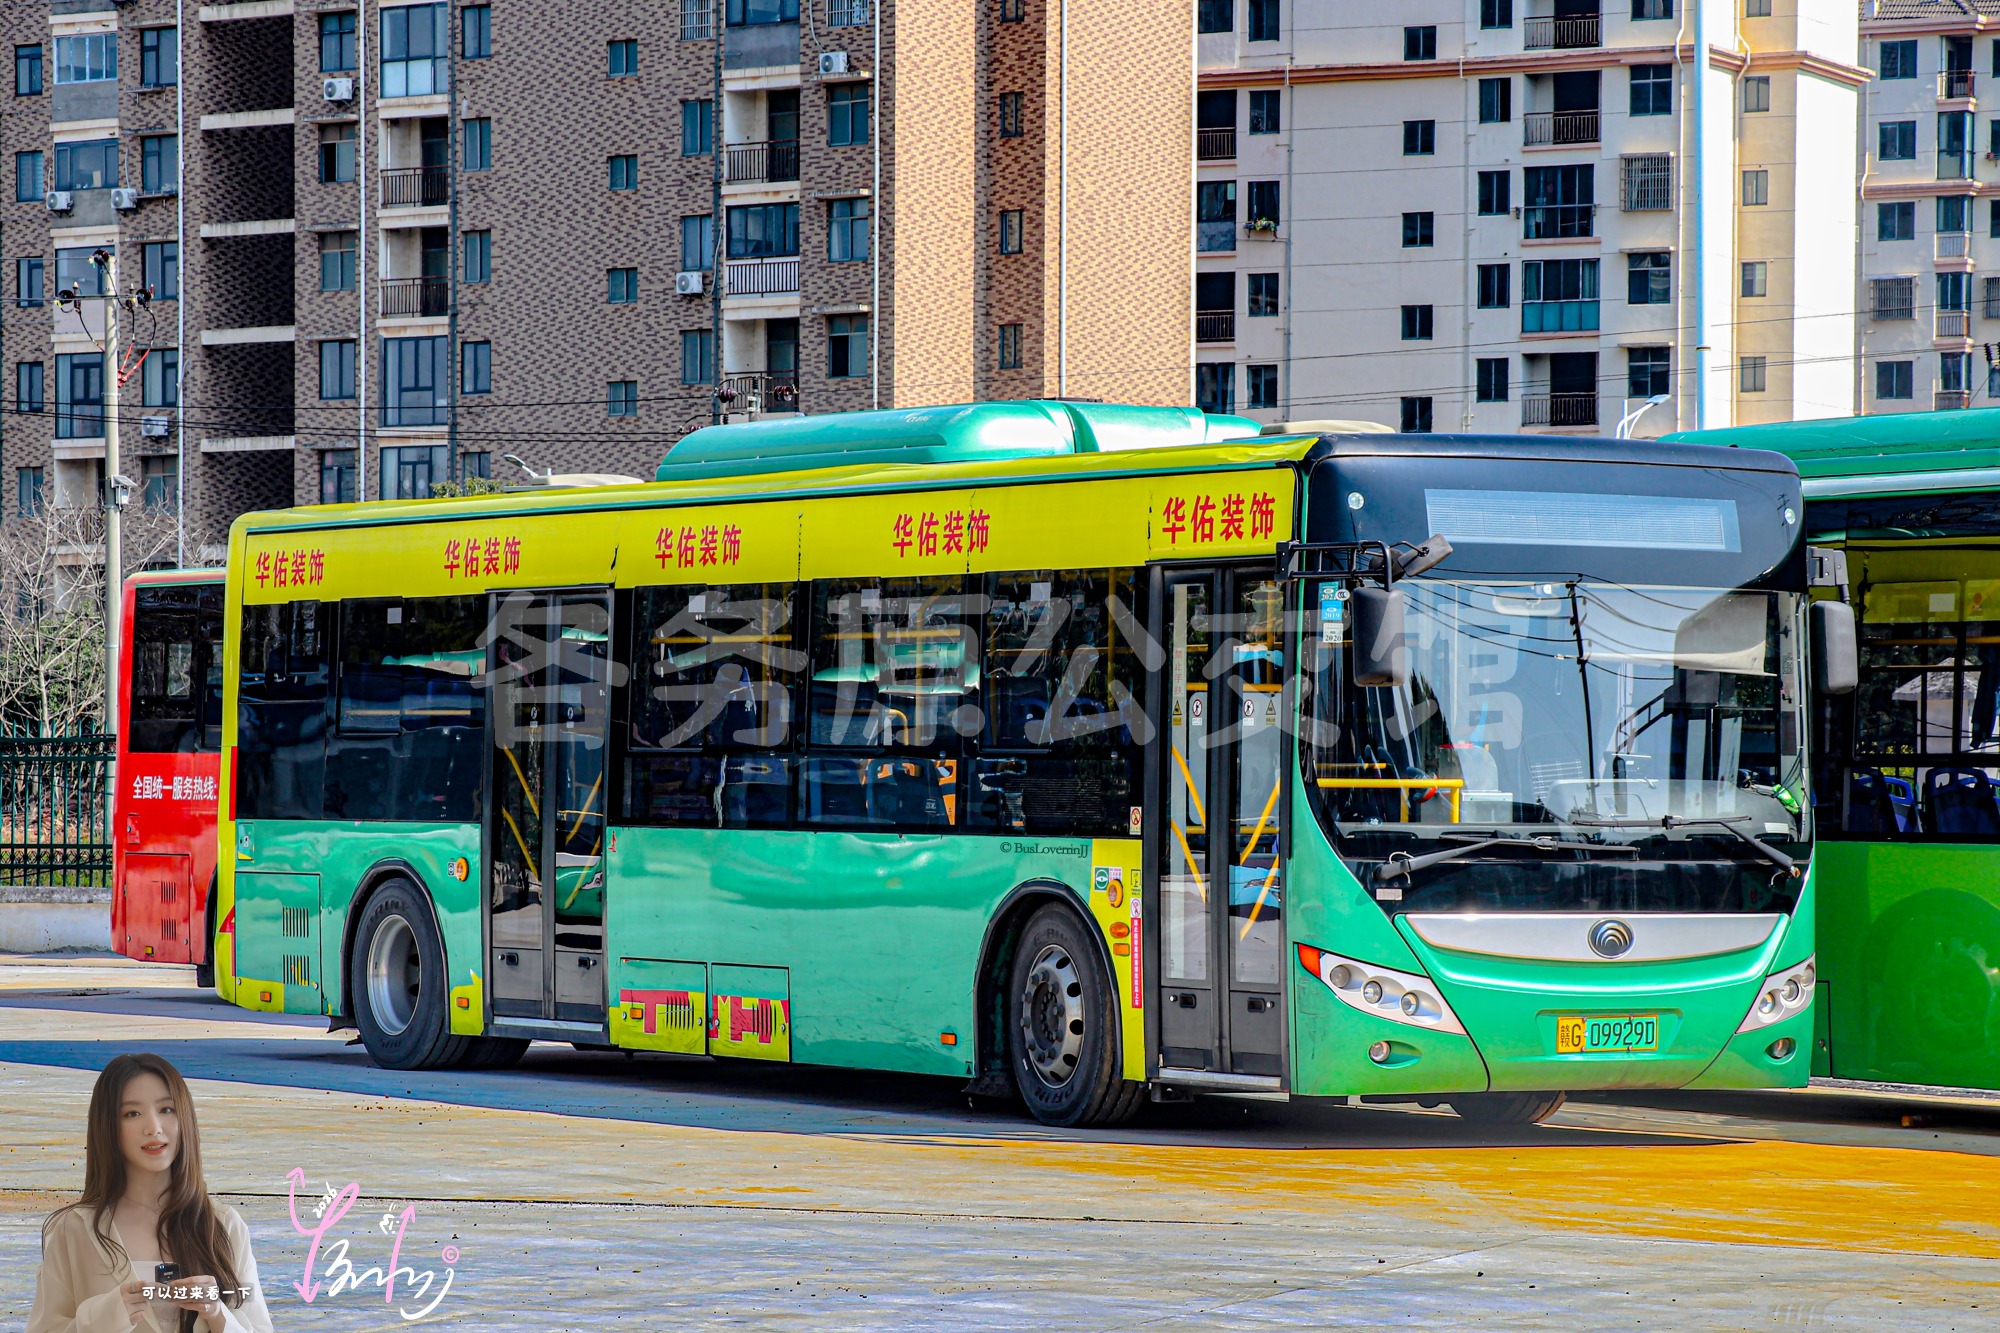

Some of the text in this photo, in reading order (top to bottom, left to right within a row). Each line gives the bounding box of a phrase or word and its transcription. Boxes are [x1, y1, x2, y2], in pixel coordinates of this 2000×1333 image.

[894, 510, 990, 556] 华佑装饰
[1163, 492, 1275, 544] 华佑装饰
[444, 538, 521, 577] 华佑装饰
[656, 526, 741, 568] 华佑装饰
[256, 552, 323, 586] 华佑装饰
